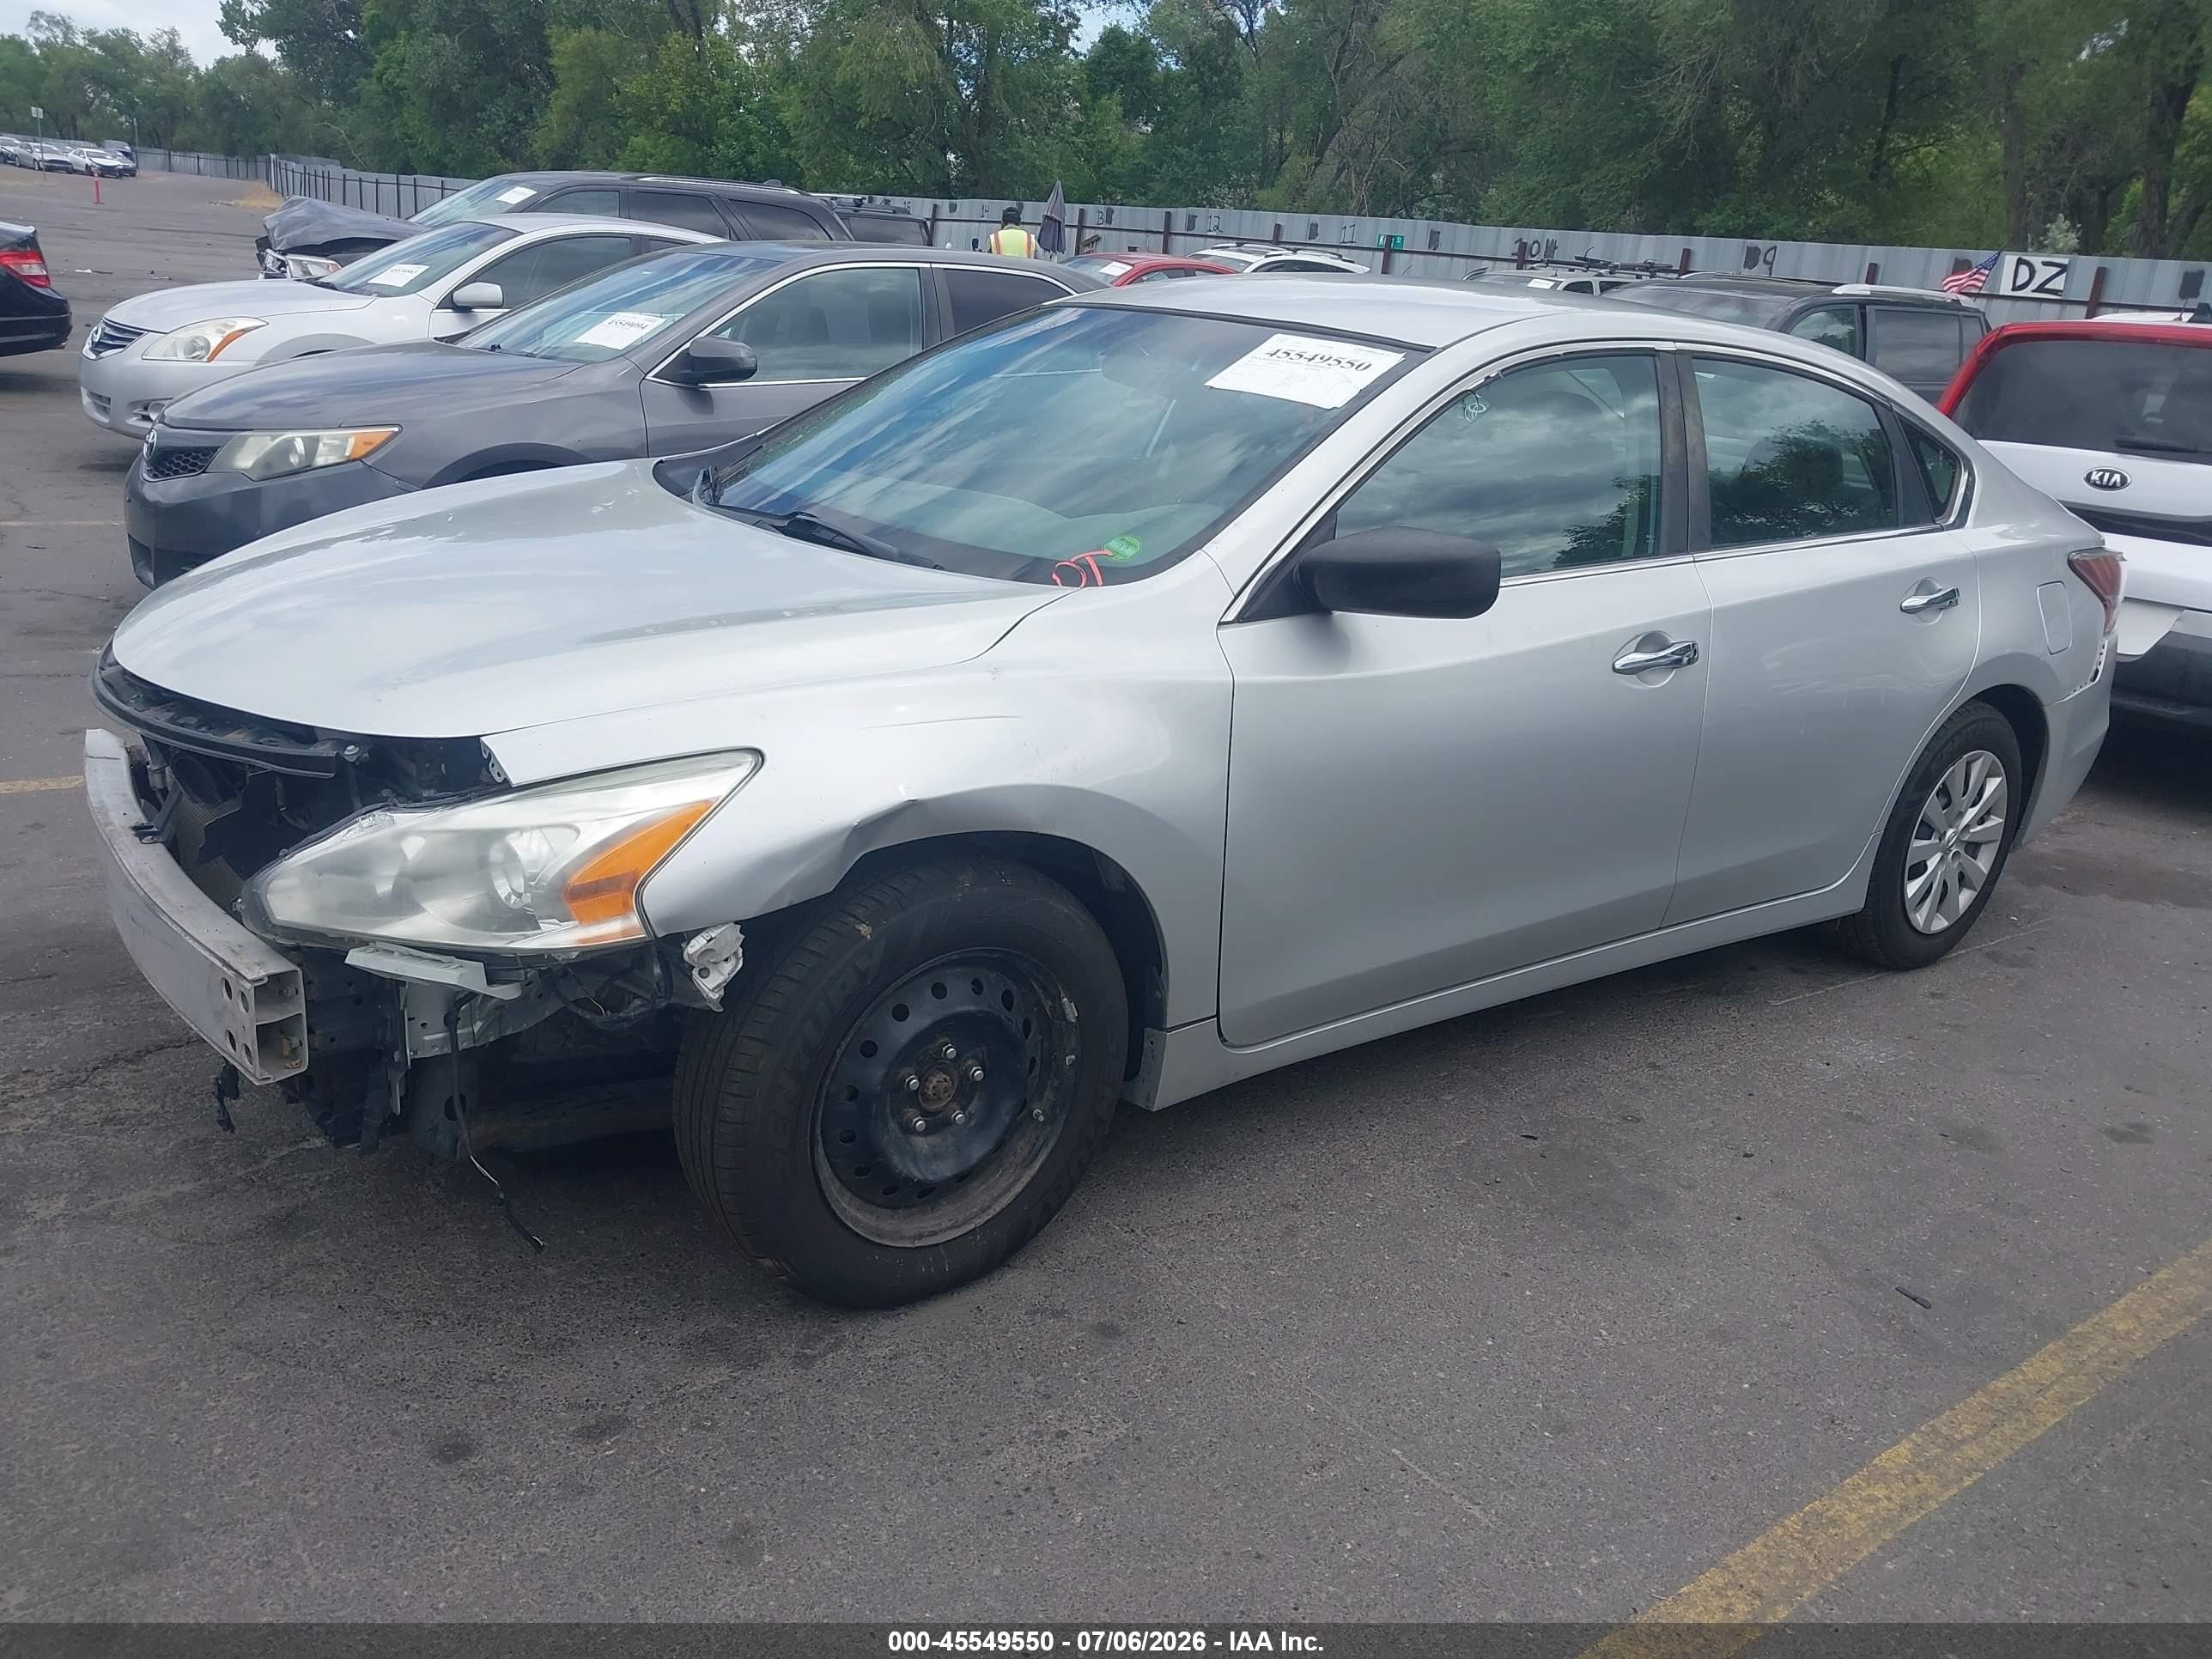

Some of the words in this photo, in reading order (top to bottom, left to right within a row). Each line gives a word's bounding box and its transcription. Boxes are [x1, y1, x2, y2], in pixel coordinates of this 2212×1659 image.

[1207, 215, 1223, 233] 12
[1340, 223, 1357, 244] 11
[2011, 257, 2069, 296] DZ
[1266, 348, 1373, 372] 45549550
[2089, 471, 2121, 487] KIA
